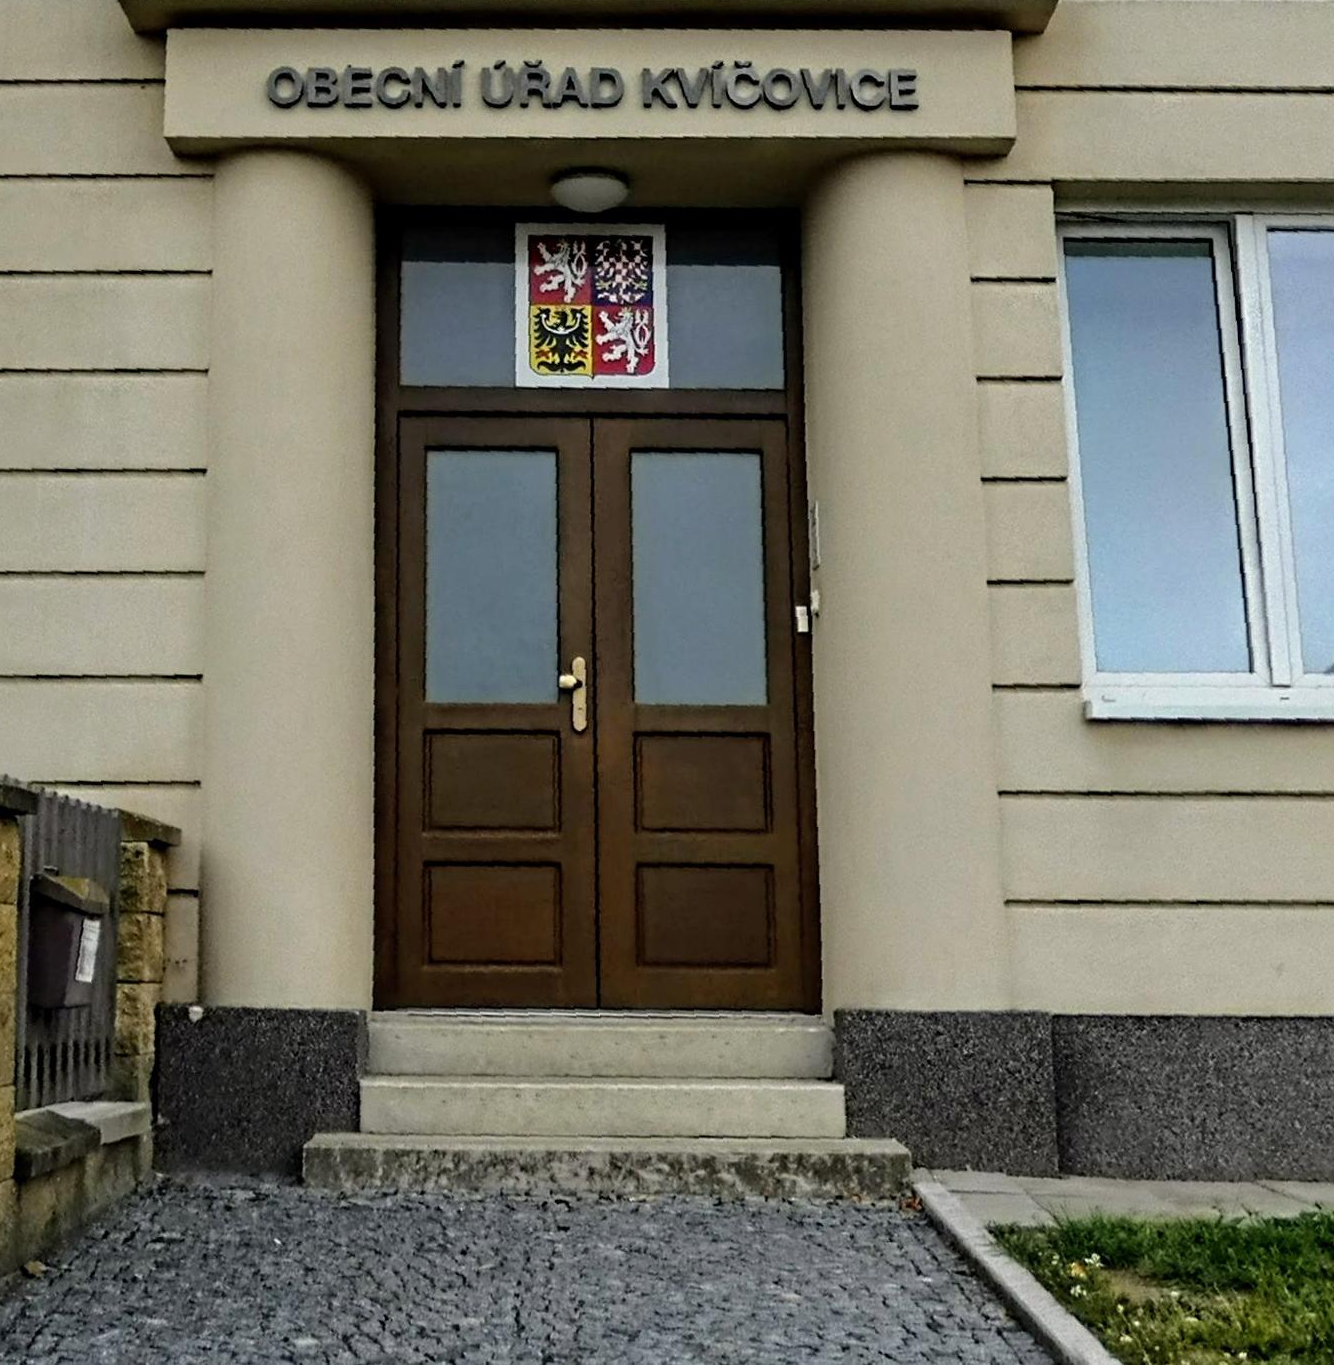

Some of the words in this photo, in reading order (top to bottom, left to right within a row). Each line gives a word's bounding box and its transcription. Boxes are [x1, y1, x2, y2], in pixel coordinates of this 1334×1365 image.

[268, 59, 465, 108] OBECNÍ
[479, 59, 625, 109] ÚŘAD
[641, 60, 919, 111] KVÍČOVICE
